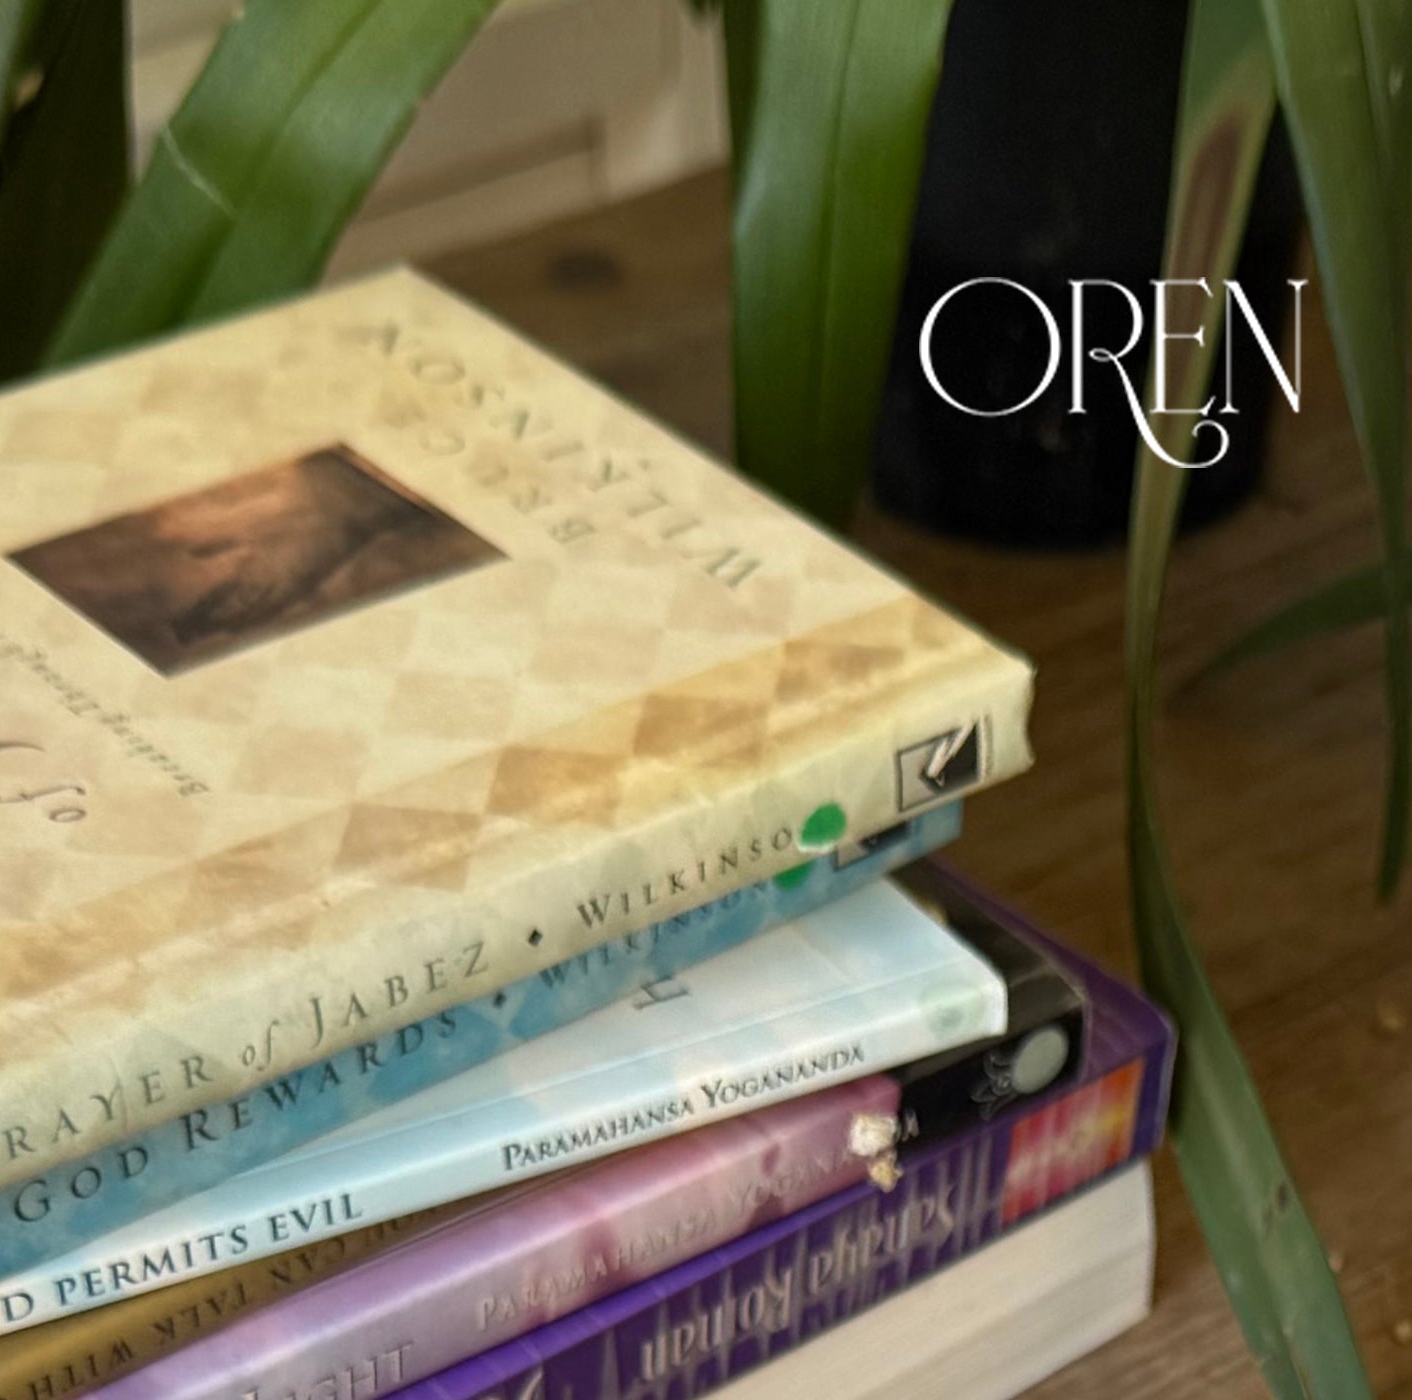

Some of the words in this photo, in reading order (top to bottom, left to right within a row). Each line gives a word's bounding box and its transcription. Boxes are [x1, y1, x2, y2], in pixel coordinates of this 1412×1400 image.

[241, 1020, 279, 1073] of
[307, 941, 488, 1046] JABEZ
[576, 826, 793, 930] WILKINSO
[14, 1145, 149, 1223] GOD
[180, 1010, 457, 1152] REWARDS
[55, 1224, 248, 1308] PERMITS
[268, 1192, 363, 1242] EVIL
[502, 1097, 695, 1172] PARAMAHANSA
[700, 1042, 865, 1110] YOGANANDA
[153, 1280, 253, 1348] TALK
